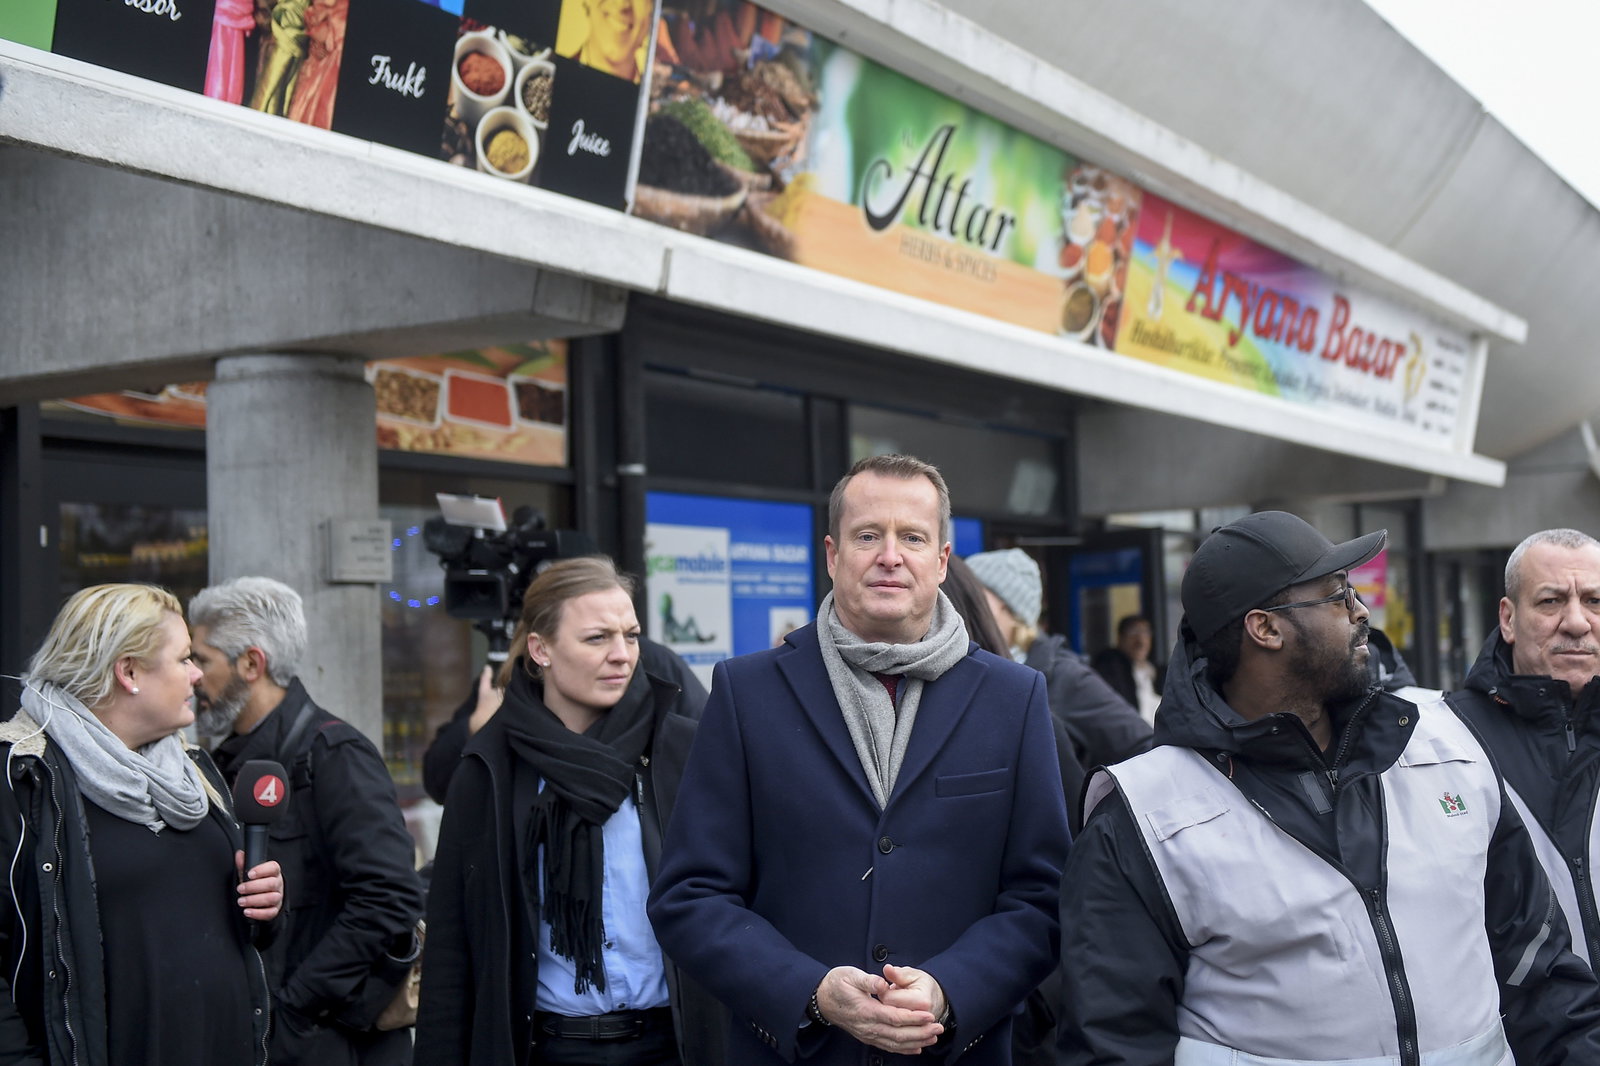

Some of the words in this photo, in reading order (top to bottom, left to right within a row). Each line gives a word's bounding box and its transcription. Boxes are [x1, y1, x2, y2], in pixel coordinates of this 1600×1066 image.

[368, 54, 427, 98] Frukt
[567, 118, 611, 157] Juice
[863, 124, 1016, 252] Attar
[1185, 237, 1321, 348] Aryana
[1320, 293, 1406, 381] Bazar
[258, 777, 277, 803] 4
